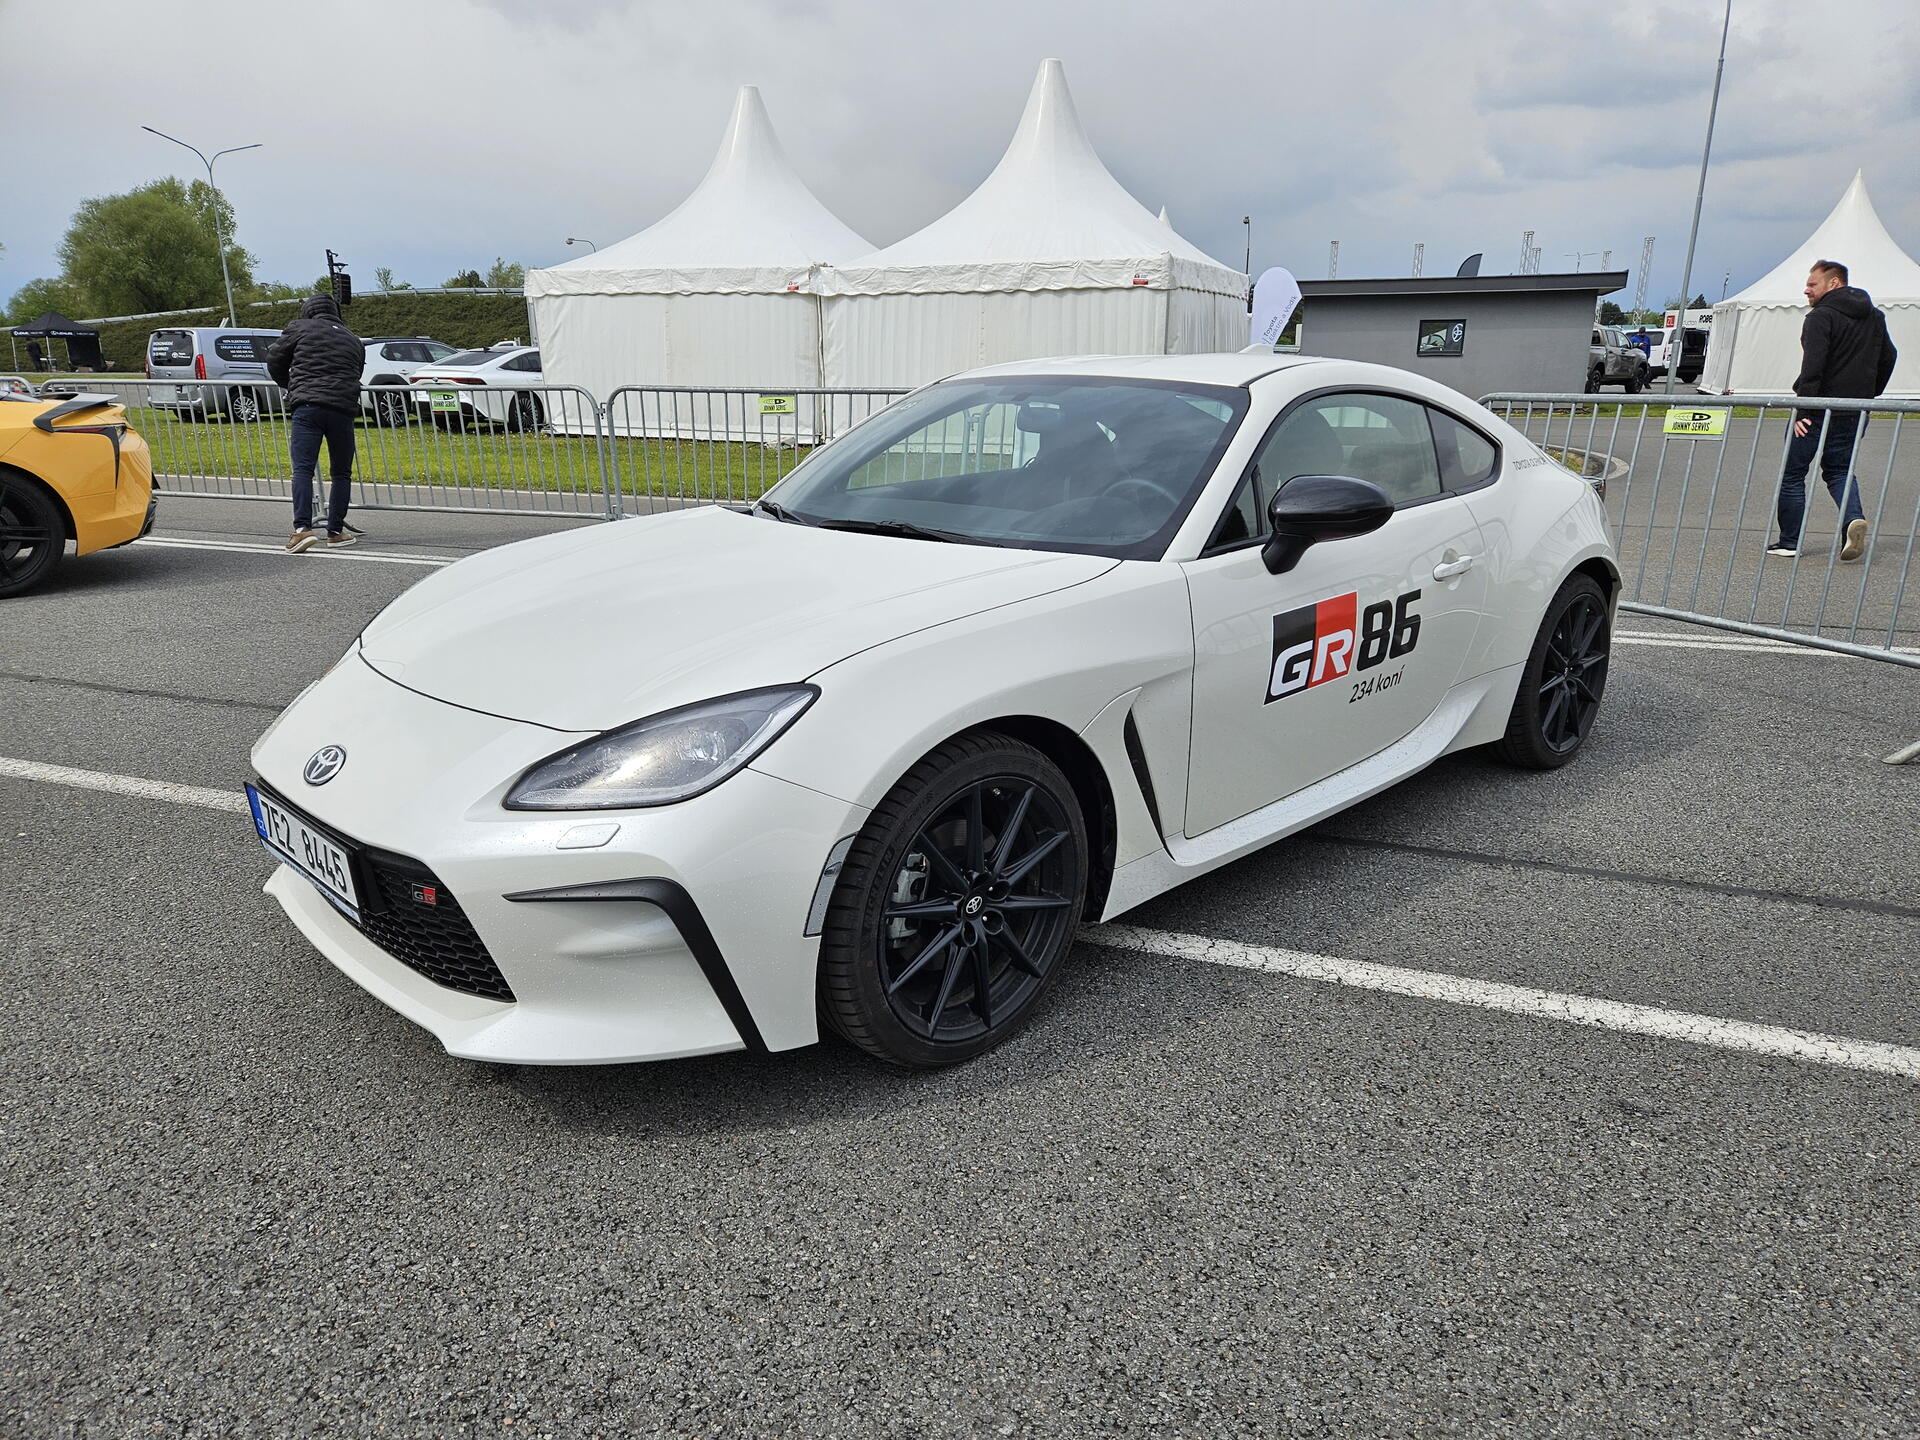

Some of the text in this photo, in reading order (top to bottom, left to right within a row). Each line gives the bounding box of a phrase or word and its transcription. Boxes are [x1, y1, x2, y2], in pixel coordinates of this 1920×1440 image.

[1264, 316, 1277, 336] Toyota
[1671, 421, 1710, 431] JOHNNY SERVIS
[1348, 664, 1406, 704] 234 koní
[260, 799, 296, 856] 7E2
[301, 828, 347, 893] 8445
[414, 891, 435, 903] GR
